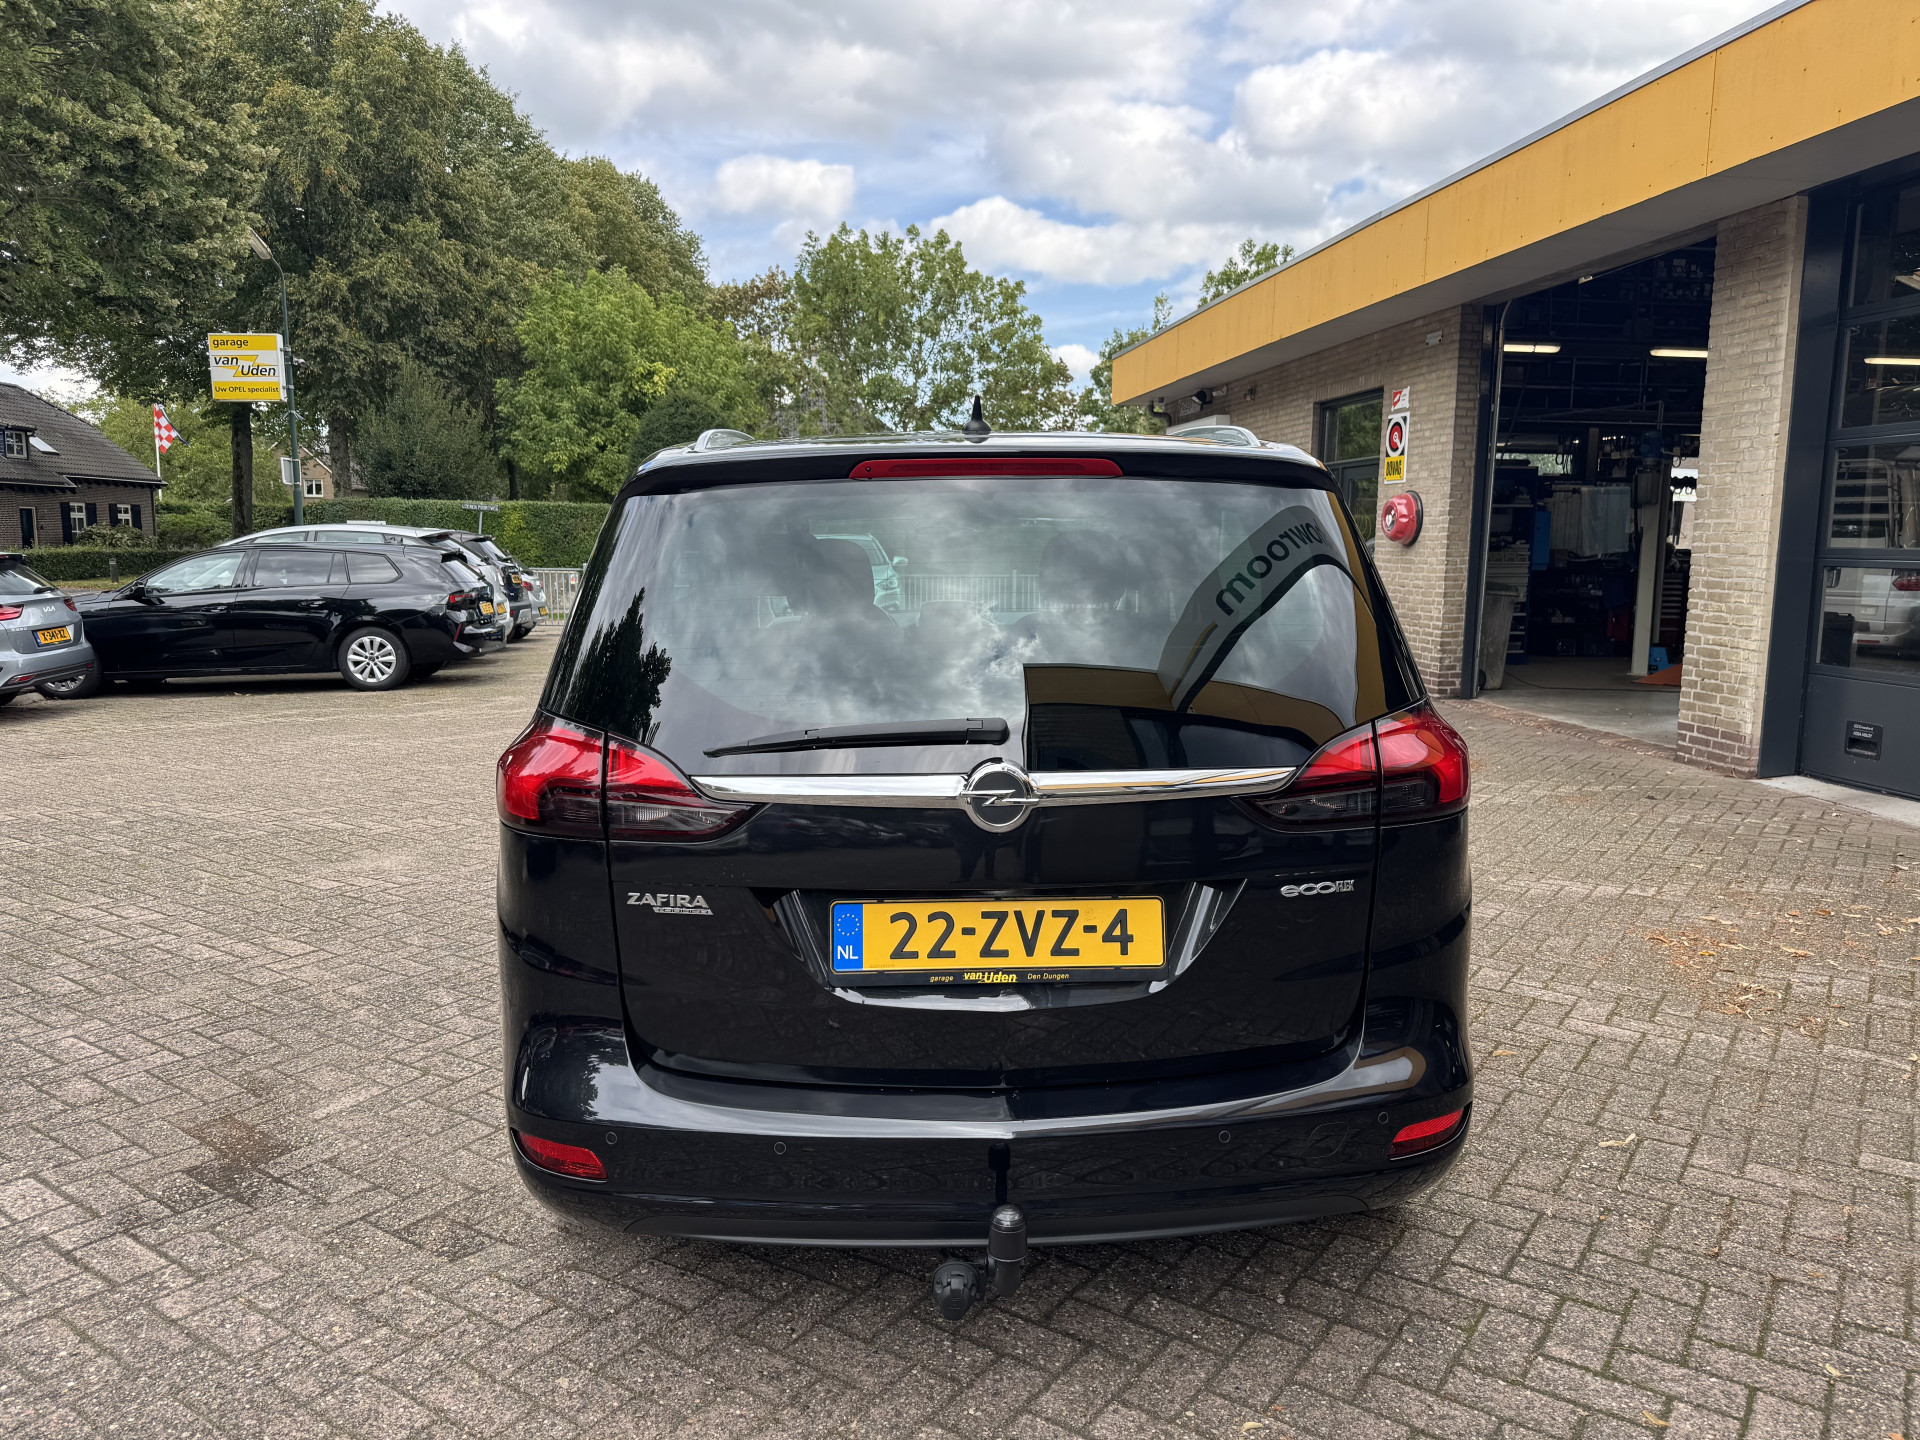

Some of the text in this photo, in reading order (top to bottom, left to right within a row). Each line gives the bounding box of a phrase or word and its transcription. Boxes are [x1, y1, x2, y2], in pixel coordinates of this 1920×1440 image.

[212, 339, 249, 349] garage
[213, 356, 276, 376] van Uden
[247, 386, 279, 394] specialist
[1385, 460, 1402, 477] BOVAG
[41, 629, 67, 642] X-341-XZ
[626, 892, 709, 909] ZAFIRA
[889, 908, 1134, 961] 22-ZVZ-4
[837, 944, 859, 961] NL
[929, 971, 1070, 984] garage van Uden Den Dungen
